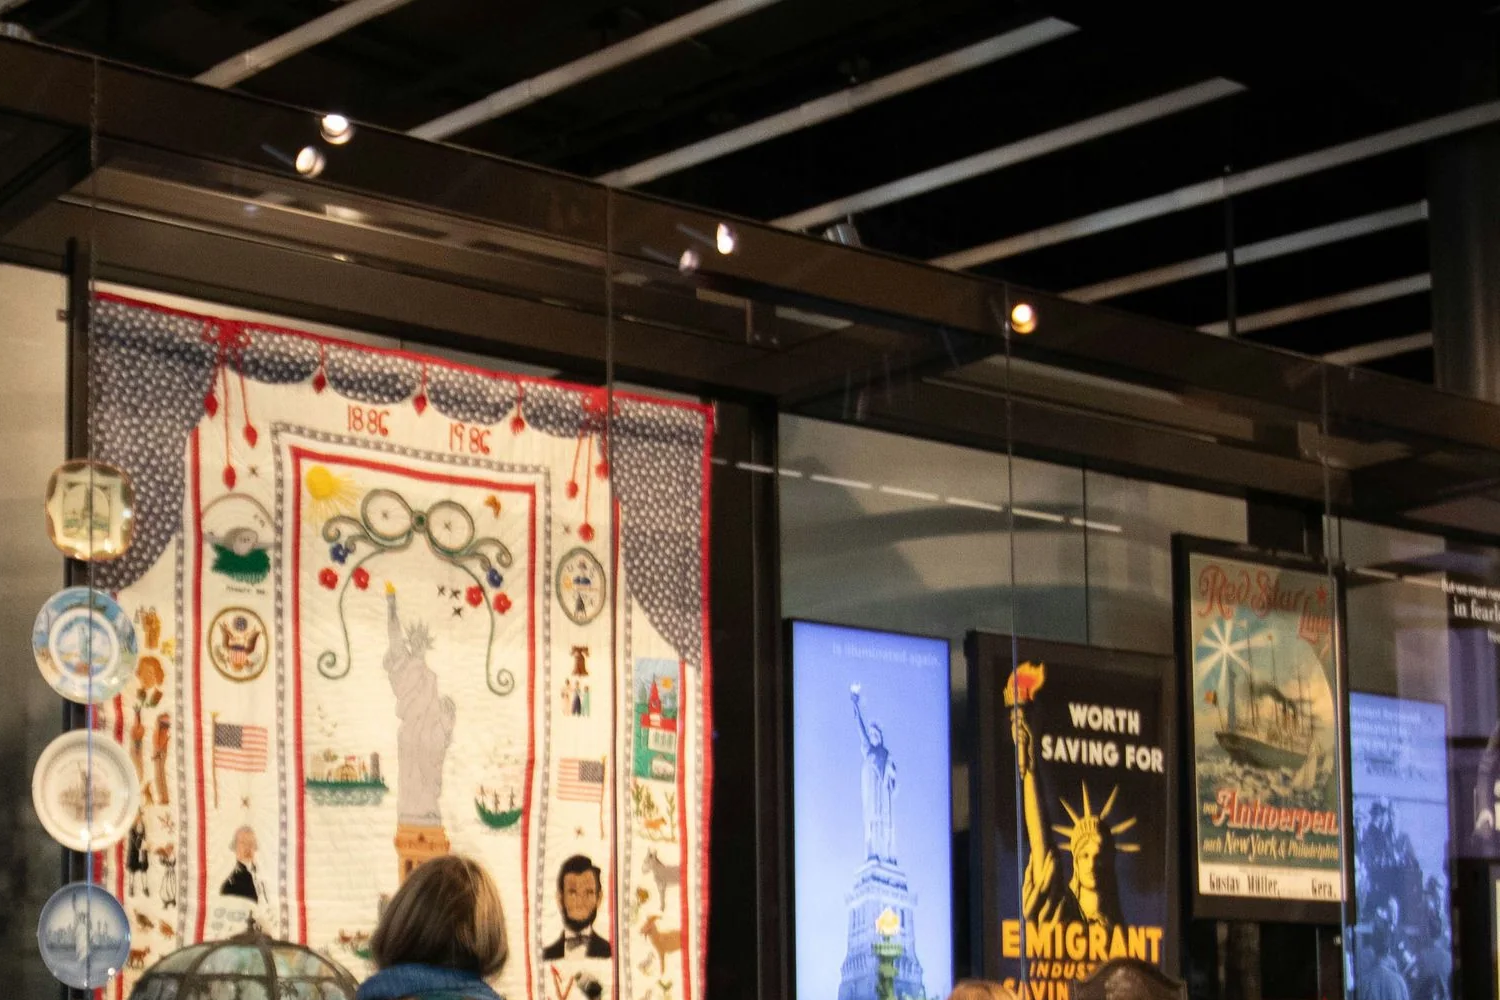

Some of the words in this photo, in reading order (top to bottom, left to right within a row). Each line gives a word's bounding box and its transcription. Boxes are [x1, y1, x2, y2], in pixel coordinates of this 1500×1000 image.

[347, 404, 389, 437] 1886
[449, 422, 491, 454] 1986
[1453, 595, 1467, 617] in
[1471, 597, 1500, 622] fearl
[1068, 701, 1141, 736] WORTH
[1041, 734, 1119, 768] SAVING
[1125, 743, 1164, 774] FOR
[1224, 830, 1249, 857] New
[1249, 831, 1277, 861] York
[1002, 919, 1163, 963] EMIGRANT
[1029, 961, 1098, 982] INDUST
